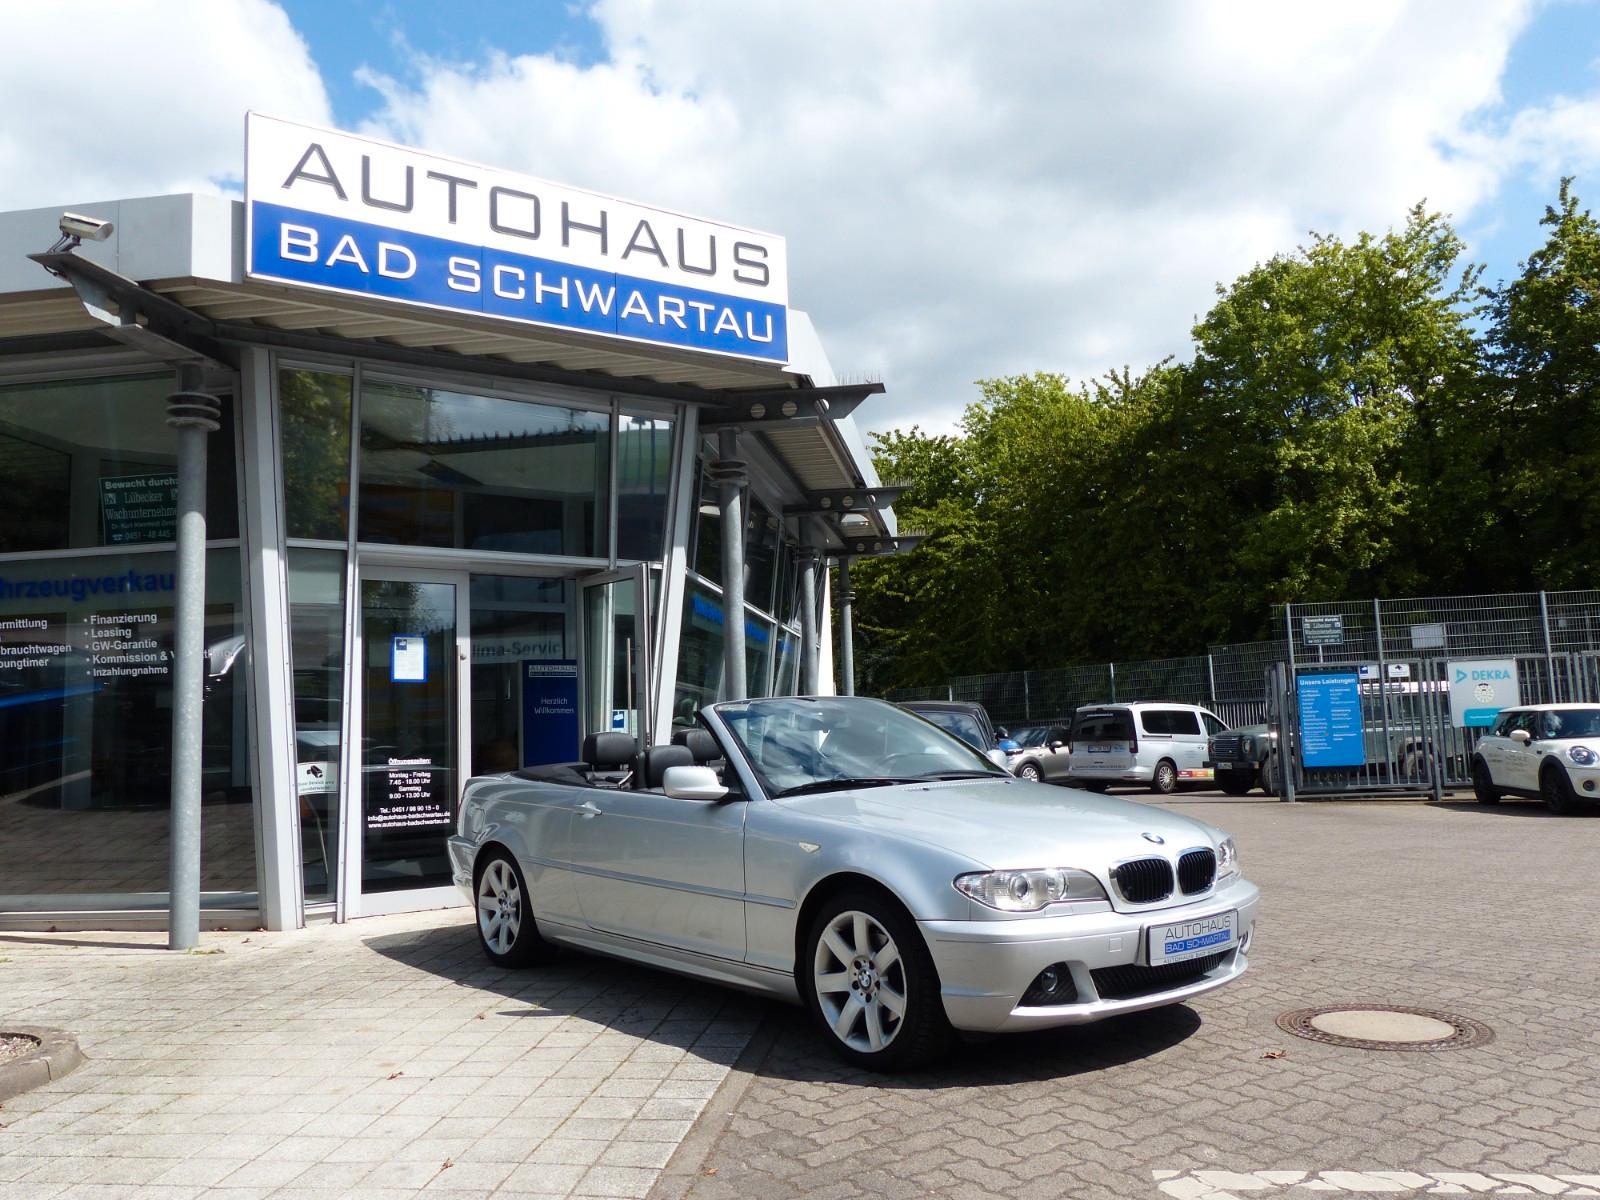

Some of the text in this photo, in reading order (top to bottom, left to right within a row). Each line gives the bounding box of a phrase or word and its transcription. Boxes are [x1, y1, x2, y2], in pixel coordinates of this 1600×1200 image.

[282, 142, 770, 287] AUTOHAUS
[280, 222, 773, 344] BAD SCHWARTAU
[104, 479, 146, 489] Bewacht
[90, 613, 158, 625] Finanzierung
[91, 627, 132, 638] Leasing
[0, 645, 72, 655] brauchtwagen
[92, 639, 158, 651] GW-Garantie
[92, 653, 157, 664] Kommission
[160, 651, 168, 660] &
[93, 666, 168, 677] Inzahlungnahme
[1472, 670, 1511, 681] DEKRA
[541, 696, 568, 705] Herzlich
[534, 706, 574, 715] Willkommen
[1165, 915, 1231, 940] AUTOHAUS
[1165, 942, 1184, 953] BAD
